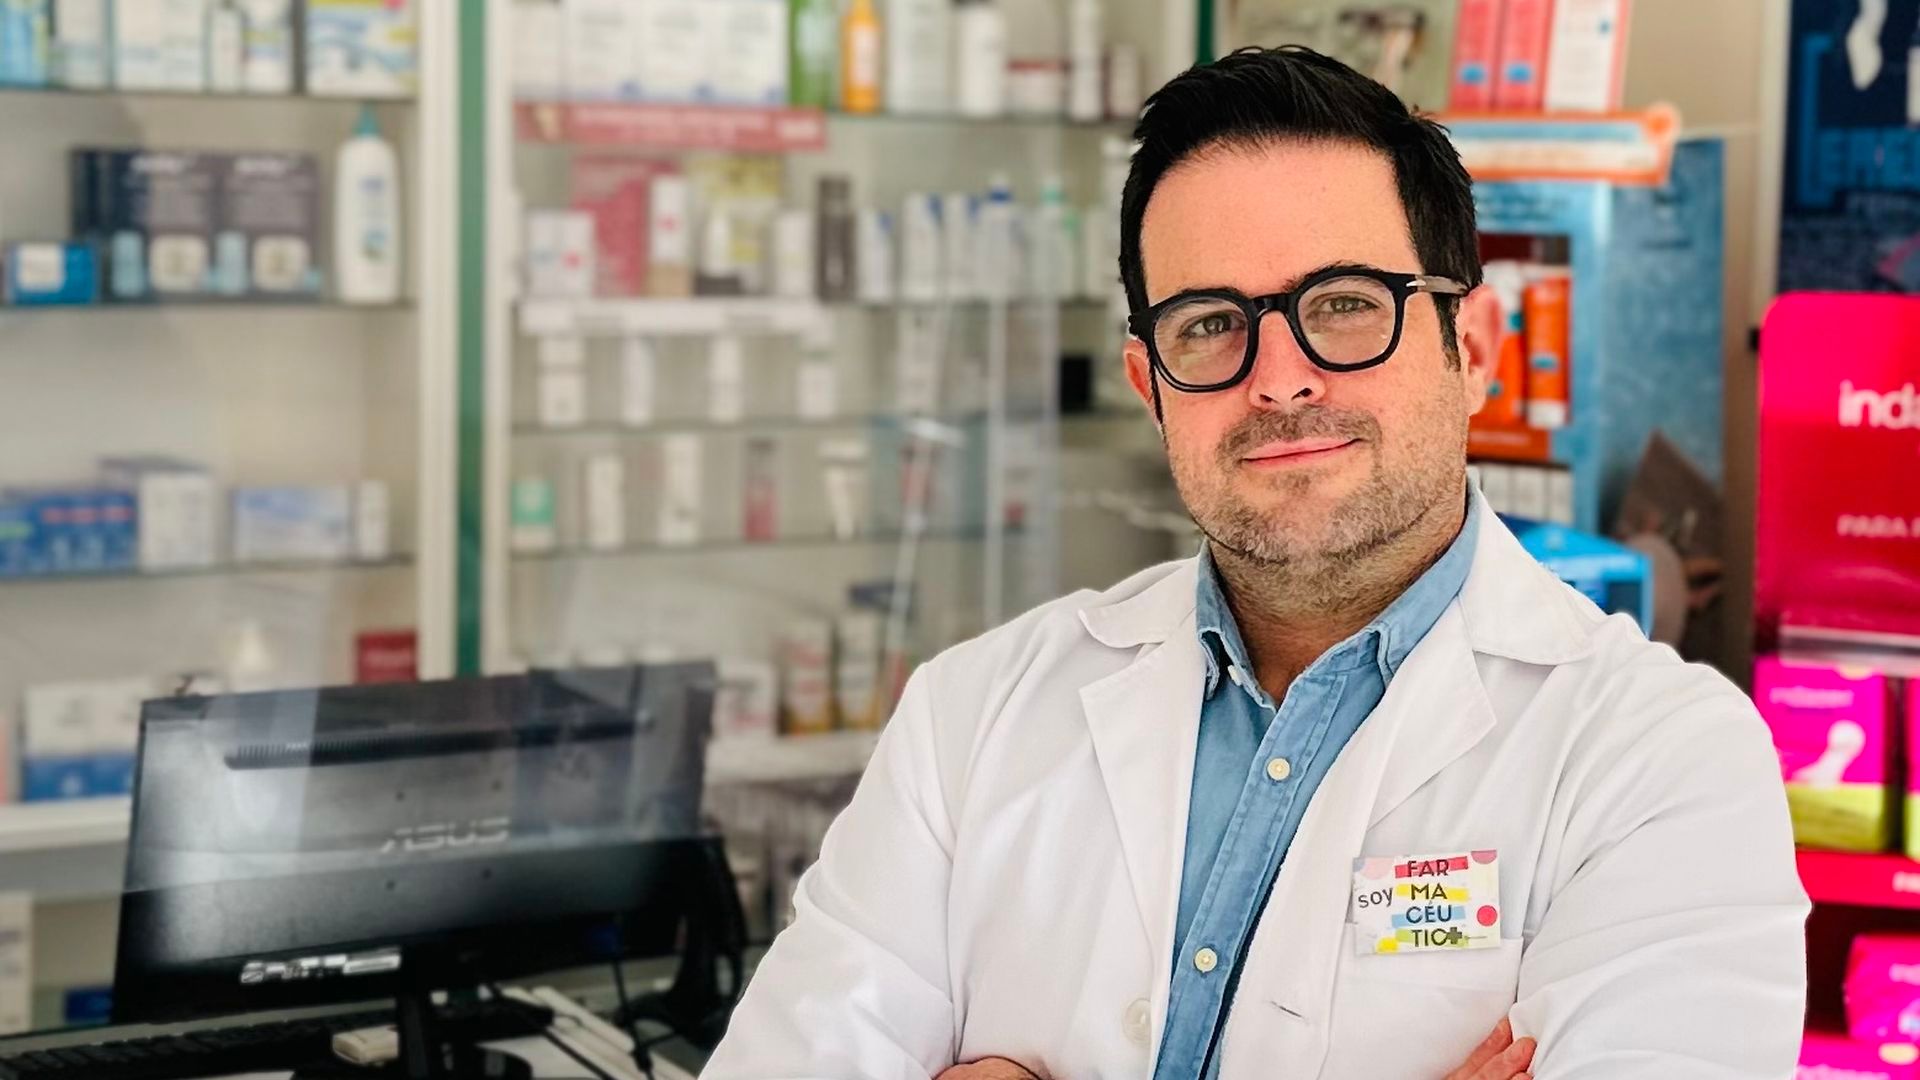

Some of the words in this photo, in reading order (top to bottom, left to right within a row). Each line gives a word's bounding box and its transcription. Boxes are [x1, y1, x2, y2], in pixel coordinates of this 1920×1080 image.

[380, 816, 510, 854] ASUS
[1407, 858, 1450, 878] FAR
[1358, 887, 1394, 909] soy
[1410, 882, 1448, 900] MA
[1405, 899, 1453, 924] CÉU
